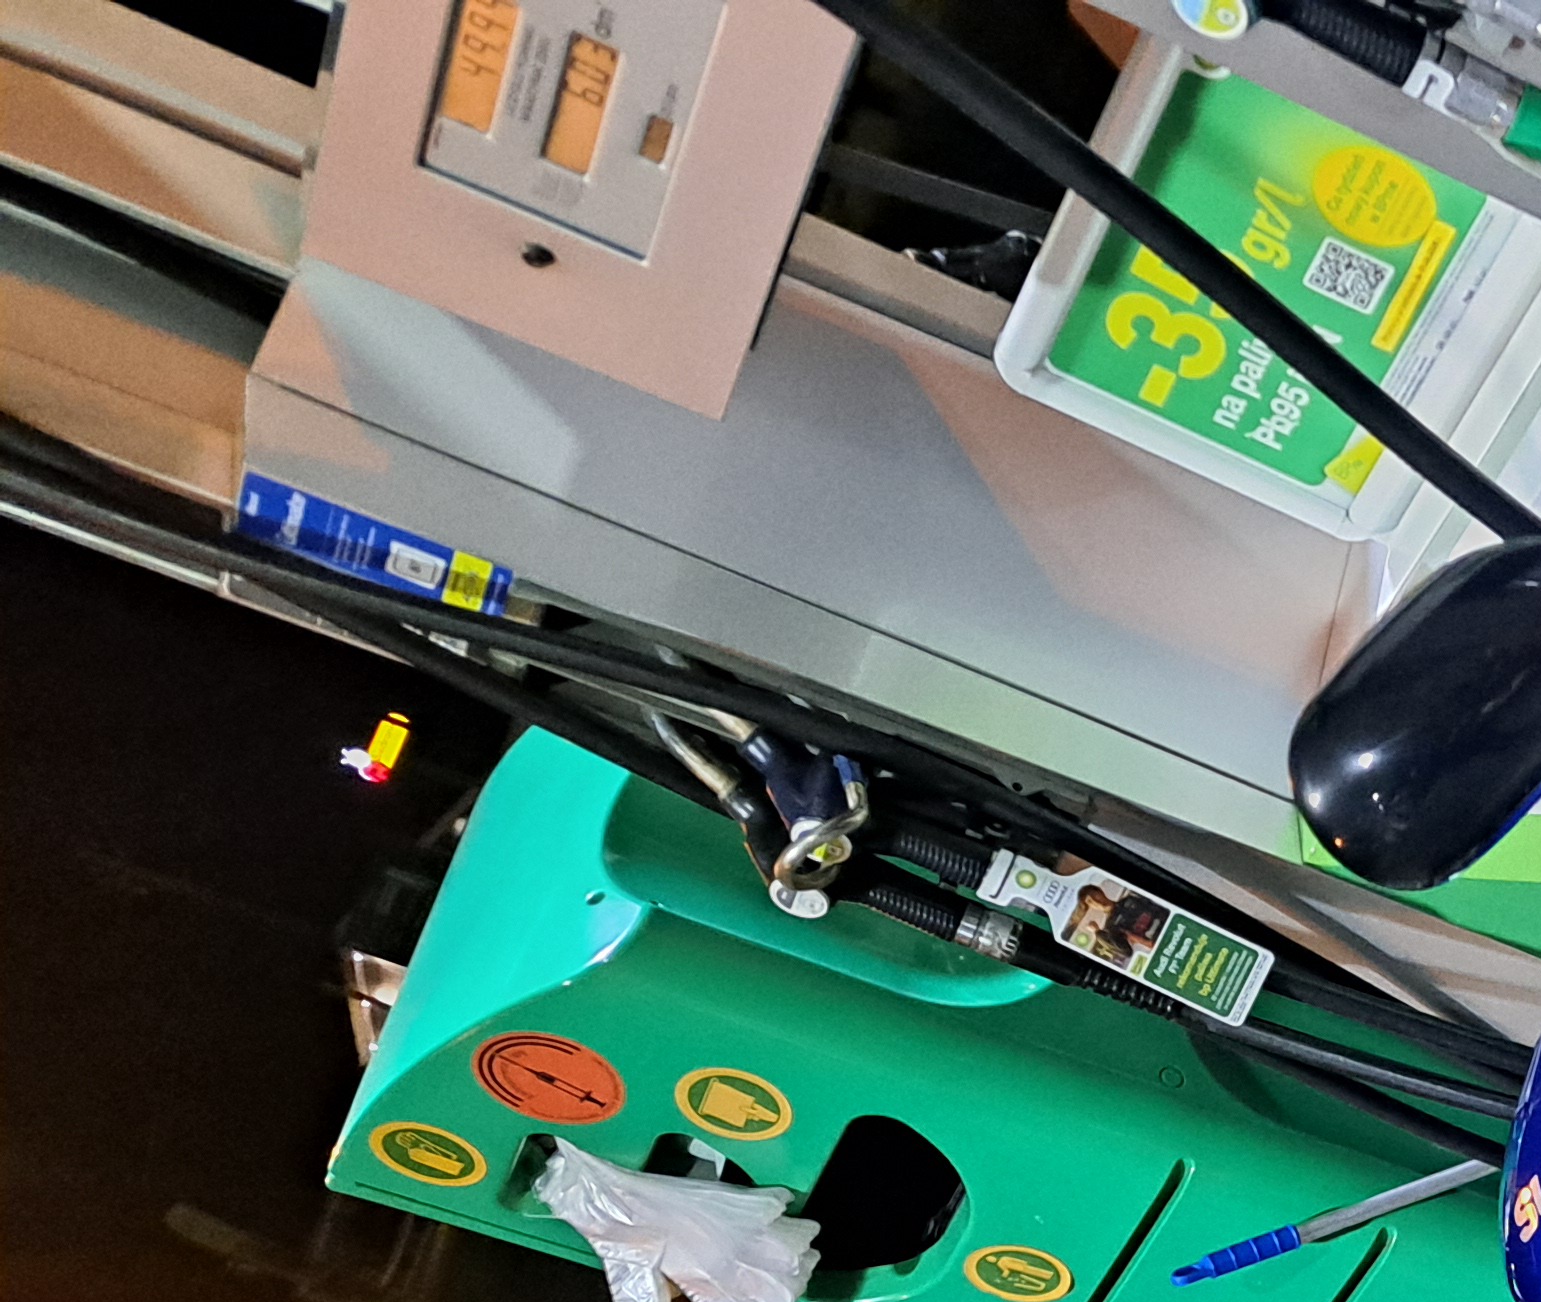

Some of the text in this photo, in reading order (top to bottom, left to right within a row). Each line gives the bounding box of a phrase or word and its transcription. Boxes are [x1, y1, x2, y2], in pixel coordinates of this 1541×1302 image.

[1212, 394, 1248, 430] na
[1245, 381, 1310, 451] Pb95
[1153, 955, 1169, 978] Audi
